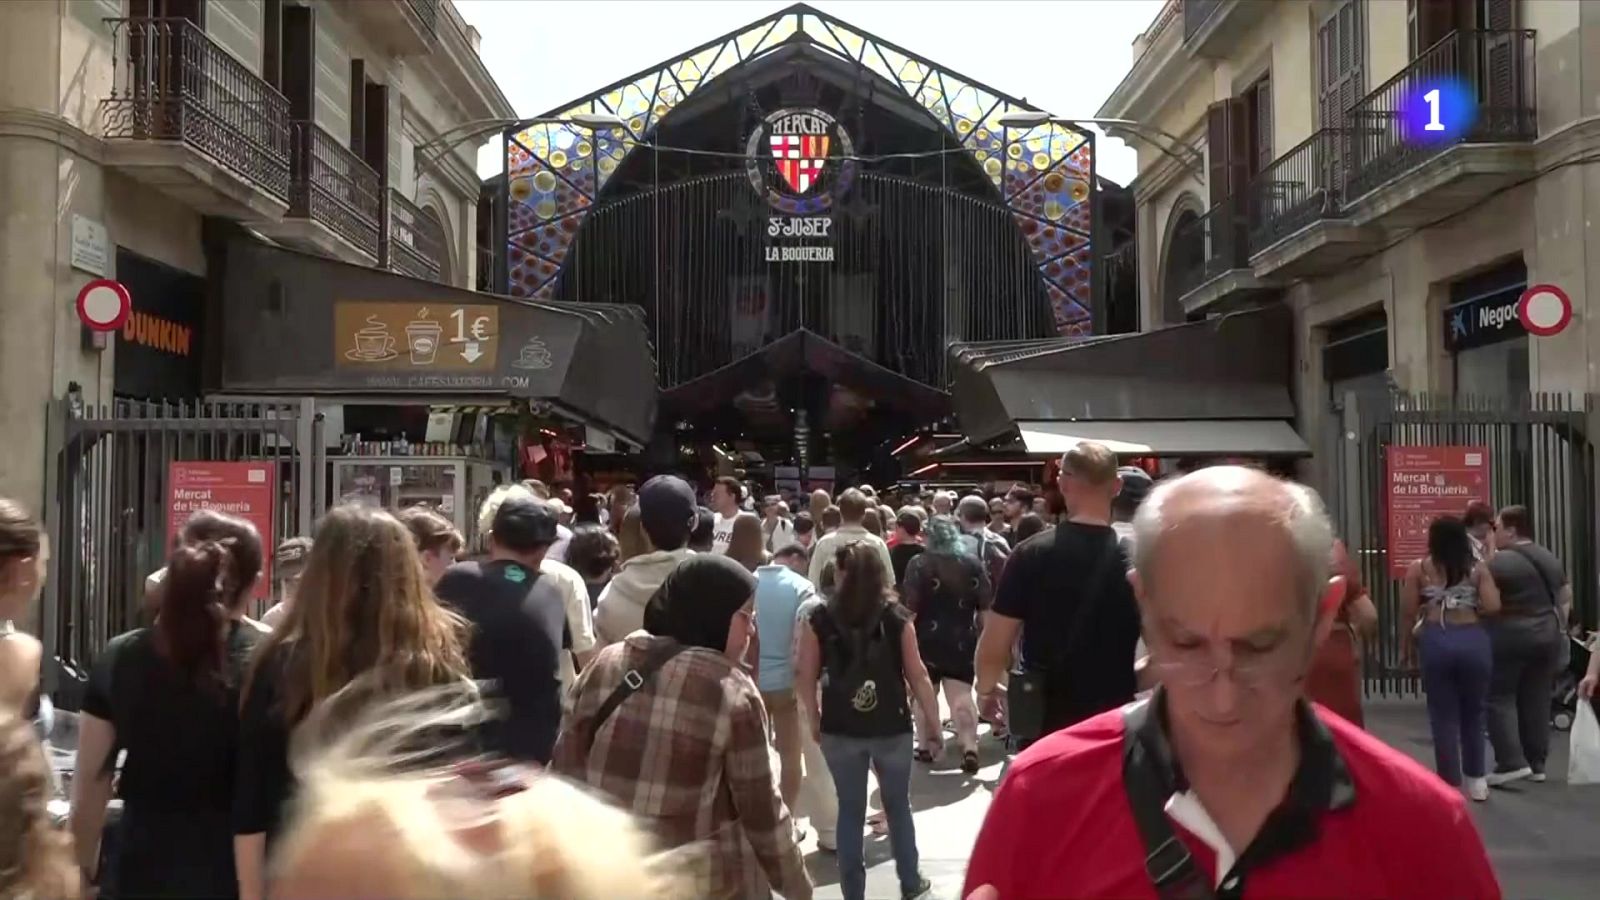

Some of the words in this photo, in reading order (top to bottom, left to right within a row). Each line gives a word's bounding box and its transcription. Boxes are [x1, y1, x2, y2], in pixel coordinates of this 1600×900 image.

[772, 114, 829, 134] MERCAT
[783, 217, 832, 236] JOSEP
[765, 247, 779, 261] LA
[782, 247, 834, 261] BOQUERIA
[123, 311, 190, 355] DUNKIN
[1393, 472, 1429, 482] Mercat
[174, 489, 211, 499] Mercat
[1393, 484, 1406, 494] de
[1408, 484, 1418, 494] la
[1420, 484, 1468, 497] Boqueria
[173, 501, 187, 511] de
[201, 501, 250, 513] Boqueria
